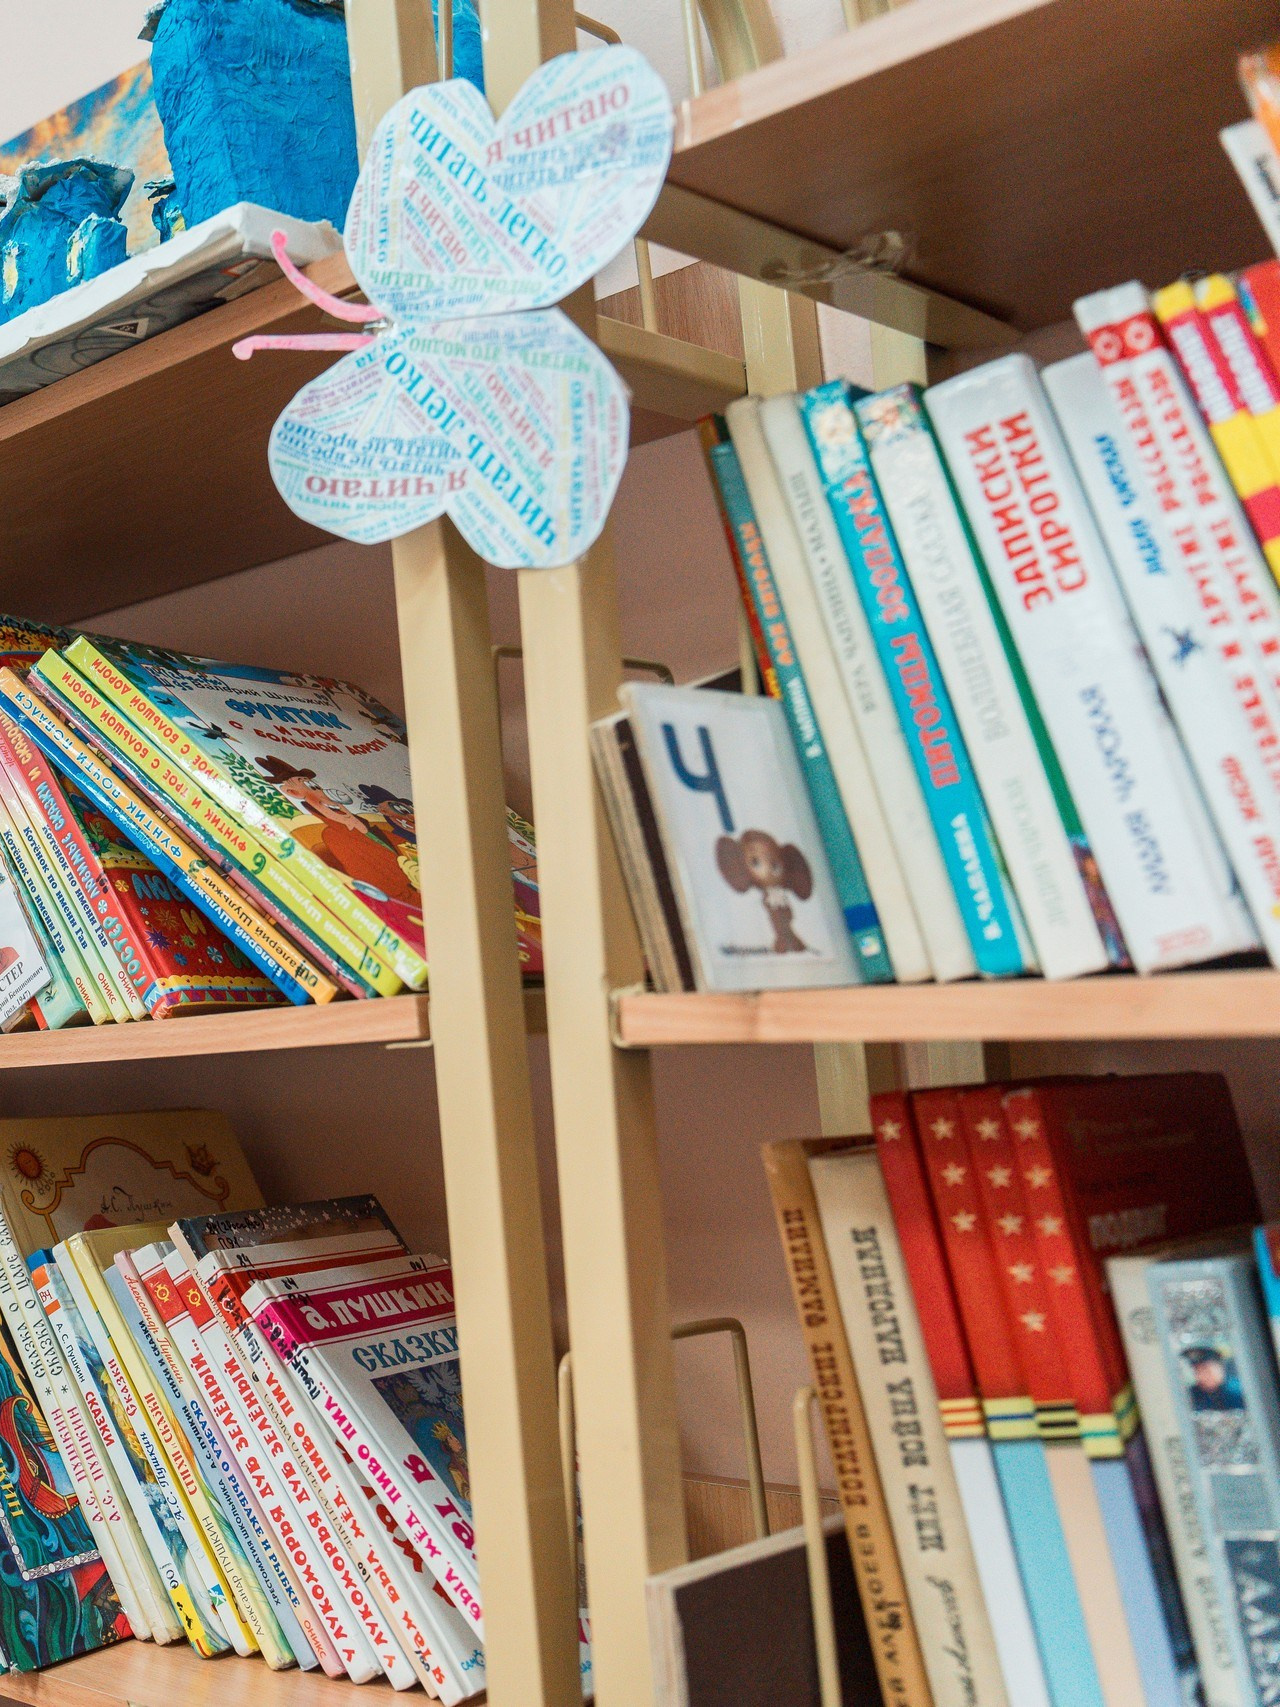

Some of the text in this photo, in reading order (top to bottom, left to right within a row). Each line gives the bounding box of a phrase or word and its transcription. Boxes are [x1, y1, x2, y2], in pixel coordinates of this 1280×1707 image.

[514, 83, 630, 151] читаю
[409, 109, 490, 204] читать
[490, 198, 568, 278] легко
[419, 198, 468, 267] читаю
[384, 351, 468, 438] легко
[305, 475, 437, 498] читаю
[467, 433, 558, 549] читать
[997, 411, 1091, 606] СИРОТКИ
[962, 424, 1056, 613] ЗАПИСКИ
[841, 470, 963, 788] ПИТОМЦЫ ЗООПАРКА
[61, 670, 102, 710] ДОРОГИ
[91, 657, 180, 746] БОЛЬШОЙ ДОРОГИ
[224, 698, 353, 731] ФУНТИК
[14, 690, 74, 755] ПОПАЛСЯ
[99, 707, 150, 759] БОЛЬШОЙ
[254, 728, 343, 754] БОЛЬШОЙ
[295, 725, 340, 743] ТРОЕ
[74, 750, 123, 801] ПОЧТИ
[151, 756, 161, 770] С
[162, 769, 191, 801] ТРОЕ
[660, 720, 736, 834] Ч
[28, 765, 102, 900] ЛЮБИМЫЕ СКАЗКИ И
[124, 800, 184, 860] ФУНТИК
[203, 805, 248, 853] ФУНТИК
[3, 828, 67, 955] Котёнок по имени Гав
[23, 826, 89, 950] Котёнок по имени Гав
[66, 870, 109, 948] по имени Гав
[75, 976, 94, 1010] ОНИКС
[97, 972, 117, 1005] ОНИКС
[117, 970, 138, 1003] ОНИКС
[4, 1249, 30, 1293] ЦАРЕ
[37, 1288, 54, 1304] ВЧ
[782, 1207, 830, 1328] ФАМИЛИИ
[850, 1223, 911, 1369] НАРОДНАЯ
[15, 1324, 45, 1379] СКАЗКА
[31, 1318, 64, 1376] СКАЗКА
[123, 1272, 185, 1386] Александр Пушкин
[137, 1320, 182, 1400] СТИХИ СКАЗКИ
[65, 1343, 87, 1384] Пушкин
[106, 1357, 138, 1418] Сказки
[50, 1407, 88, 1482] ПУШКИН
[65, 1405, 102, 1482] ПУШКИН
[84, 1390, 115, 1448] СКАЗКИ
[181, 1404, 211, 1456] ПУШКИН
[892, 1373, 935, 1474] ВОЙНА
[139, 1431, 172, 1492] Пушкин
[279, 1461, 311, 1505] ДУБ
[293, 1421, 334, 1484] ПИВО
[83, 1486, 104, 1524] А.С.
[101, 1486, 122, 1523] А.С.
[189, 1399, 301, 1609] СКАЗКА О РЫБАКЕ И РЫБКЕ
[332, 1484, 365, 1540] МЁД,
[356, 1442, 442, 1559] МЁД, ПИВО
[218, 1478, 282, 1608] ХРЕСТОМАТИЯ ШКОЛЬНИКА
[244, 1455, 355, 1664] У ЛУКОМОРЬЯ ДУБ
[365, 1542, 400, 1605] БЫЛ,
[201, 1515, 266, 1637] Александр ПУШКИН
[306, 1509, 389, 1646] ЛУКОМОРЬЯ
[302, 1618, 326, 1660] ОНИКС
[383, 1653, 397, 1669] У
[432, 1665, 447, 1687] Я
